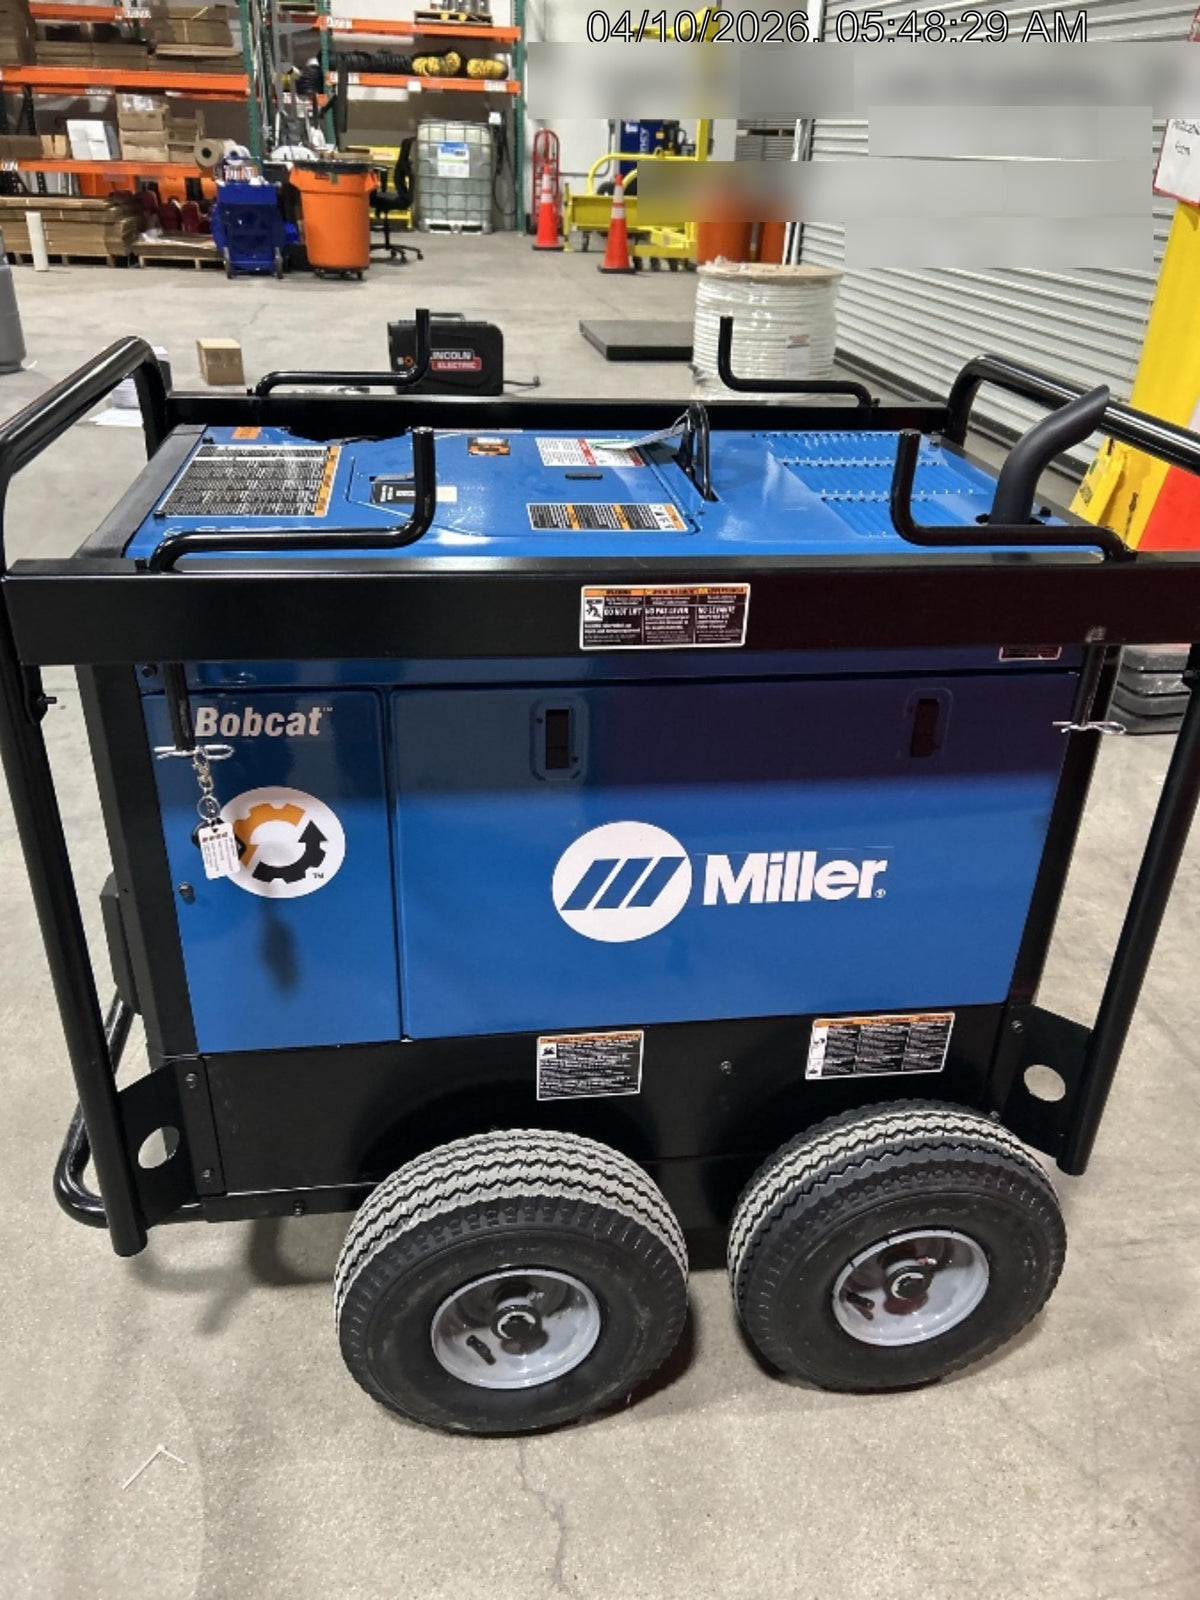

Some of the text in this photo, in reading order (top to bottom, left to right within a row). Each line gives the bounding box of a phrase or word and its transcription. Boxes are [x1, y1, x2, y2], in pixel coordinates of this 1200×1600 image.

[437, 361, 477, 369] ELECTRIC
[195, 706, 322, 737] Bobcat
[703, 850, 888, 906] Miller
